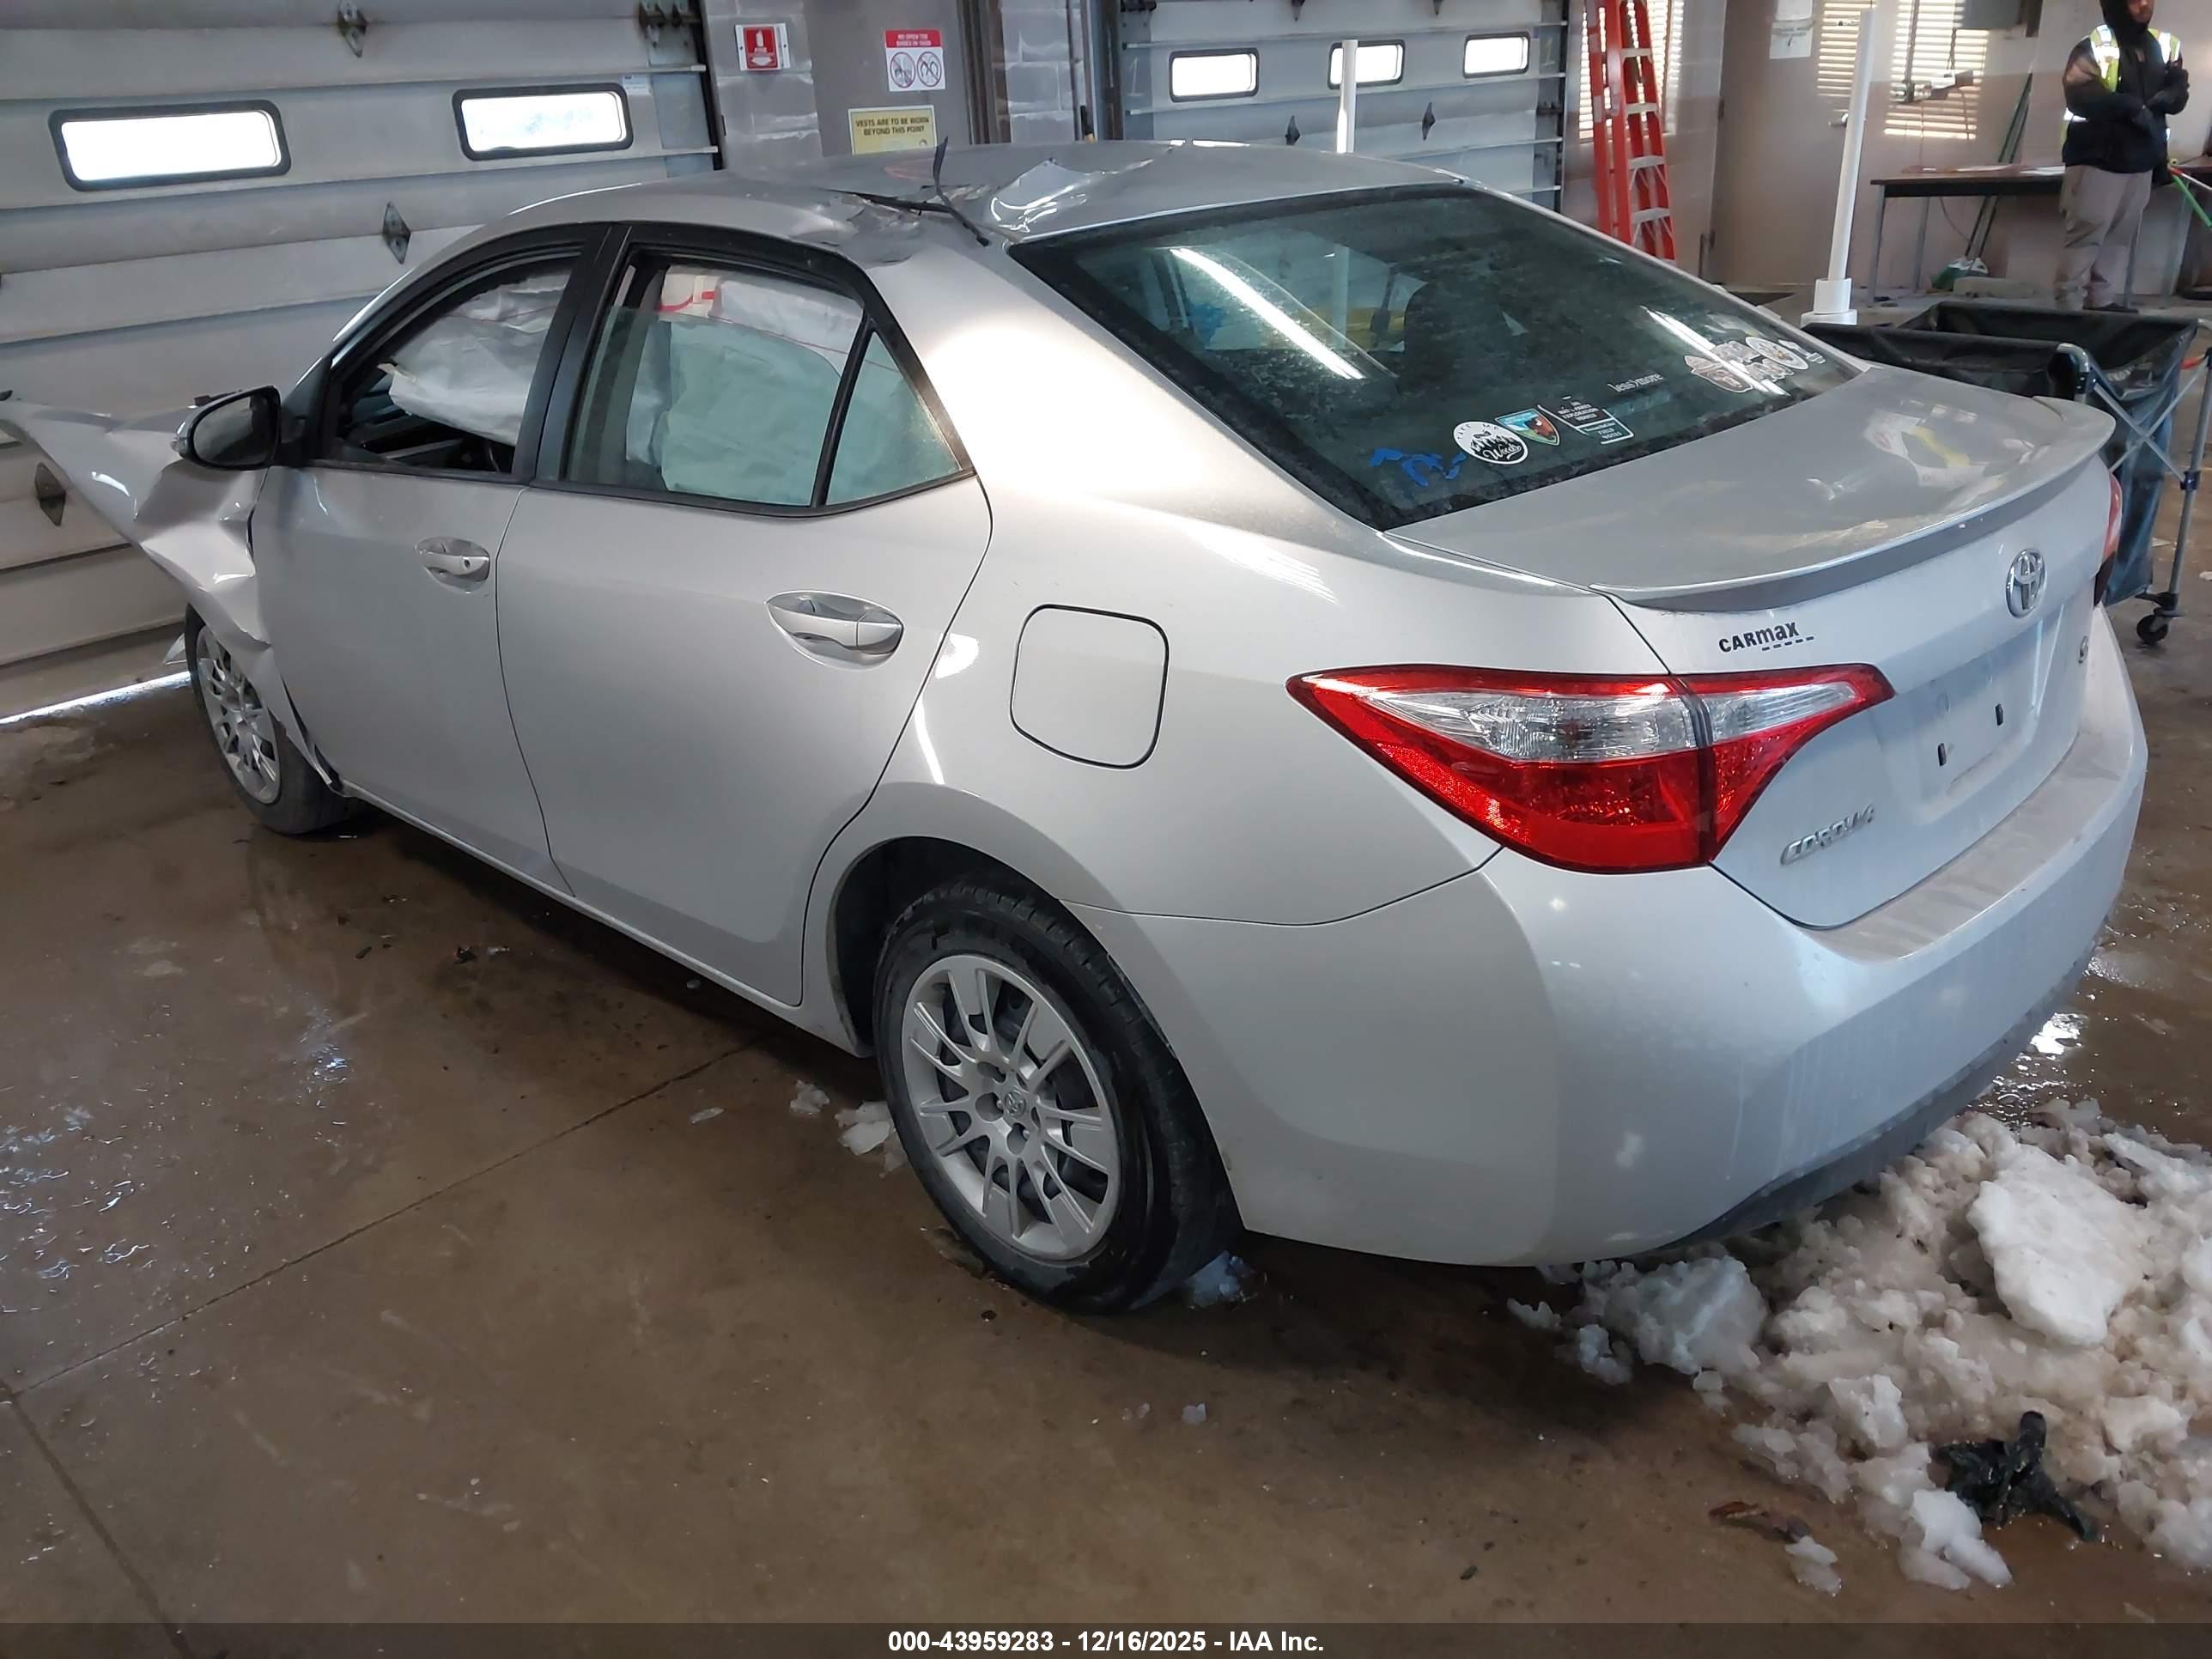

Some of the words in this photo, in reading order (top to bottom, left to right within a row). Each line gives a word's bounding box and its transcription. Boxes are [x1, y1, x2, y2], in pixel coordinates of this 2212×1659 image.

[856, 119, 876, 128] VESTS
[877, 118, 889, 126] ARE
[864, 127, 890, 136] BEYOND
[907, 125, 925, 133] POINT
